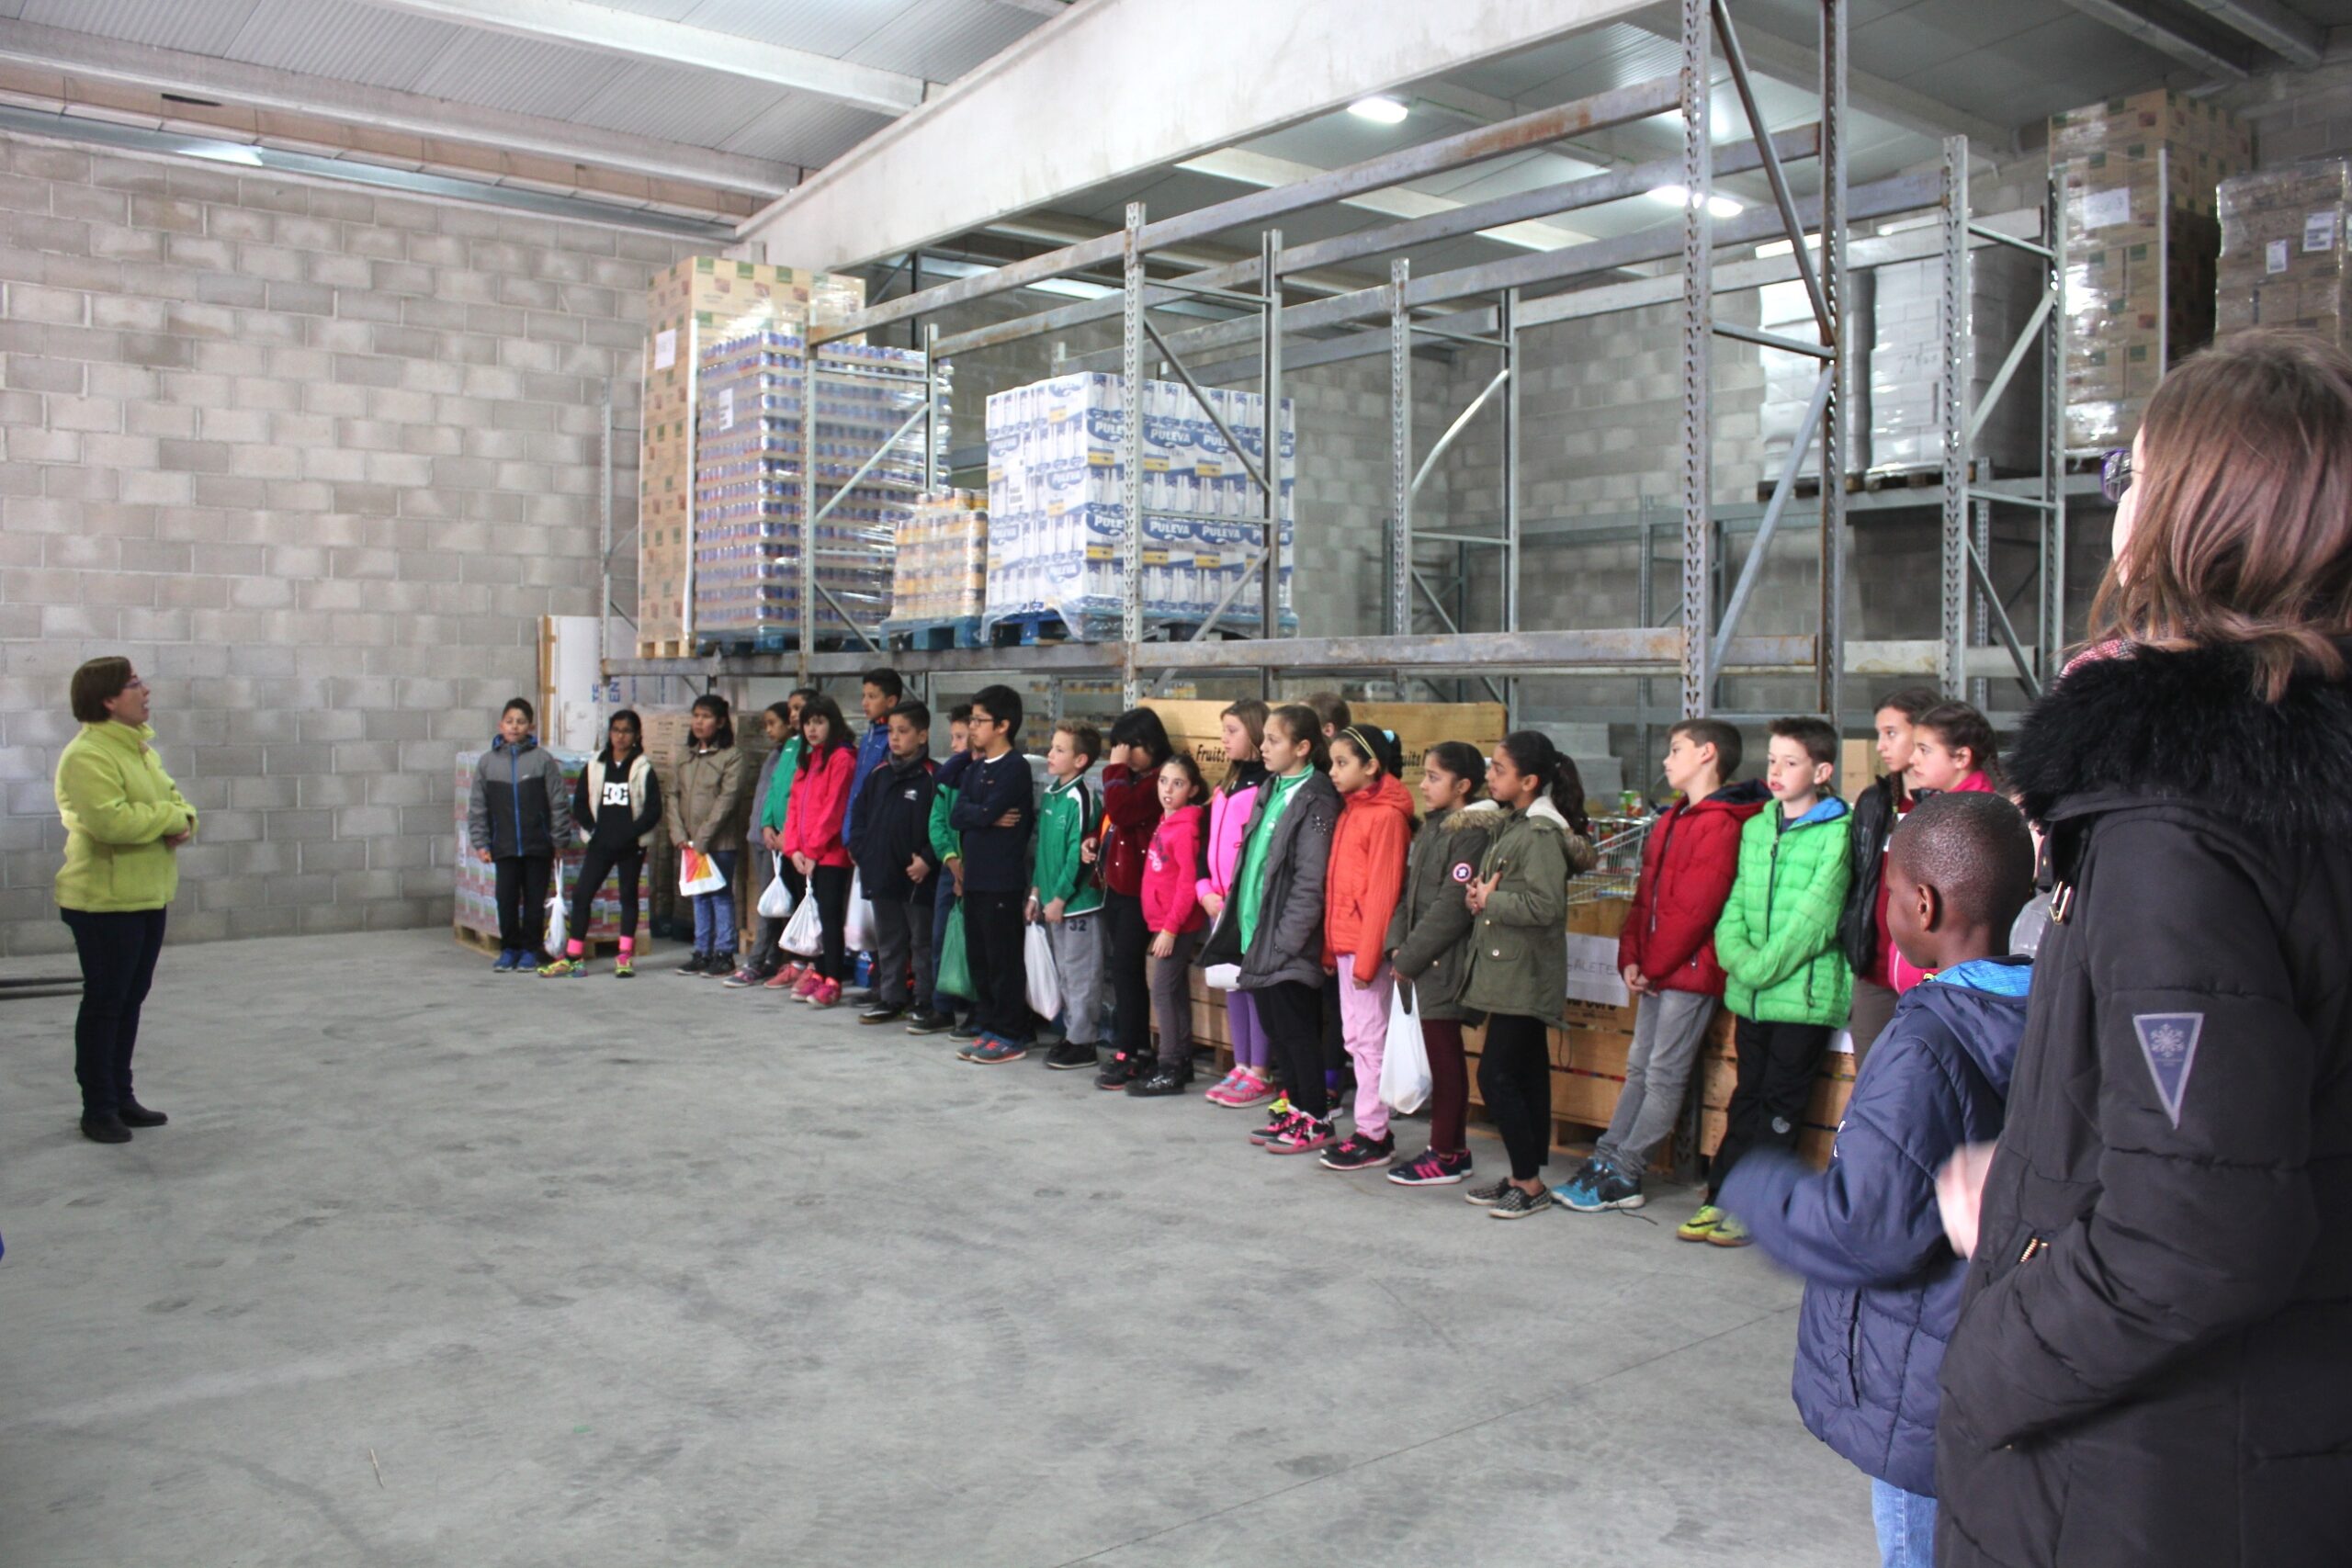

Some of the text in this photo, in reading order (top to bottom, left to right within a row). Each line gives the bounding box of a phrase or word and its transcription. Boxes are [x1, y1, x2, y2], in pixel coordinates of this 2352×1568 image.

[1094, 421, 1125, 435] PULE
[1150, 428, 1192, 443] PULEVA
[1093, 515, 1125, 530] PULE
[1149, 521, 1191, 535] PULEVA
[1202, 525, 1241, 539] PULEVA
[1196, 744, 1226, 763] Fruits
[1403, 749, 1421, 766] uits
[1069, 919, 1087, 932] 32
[1567, 958, 1619, 976] ALETE
